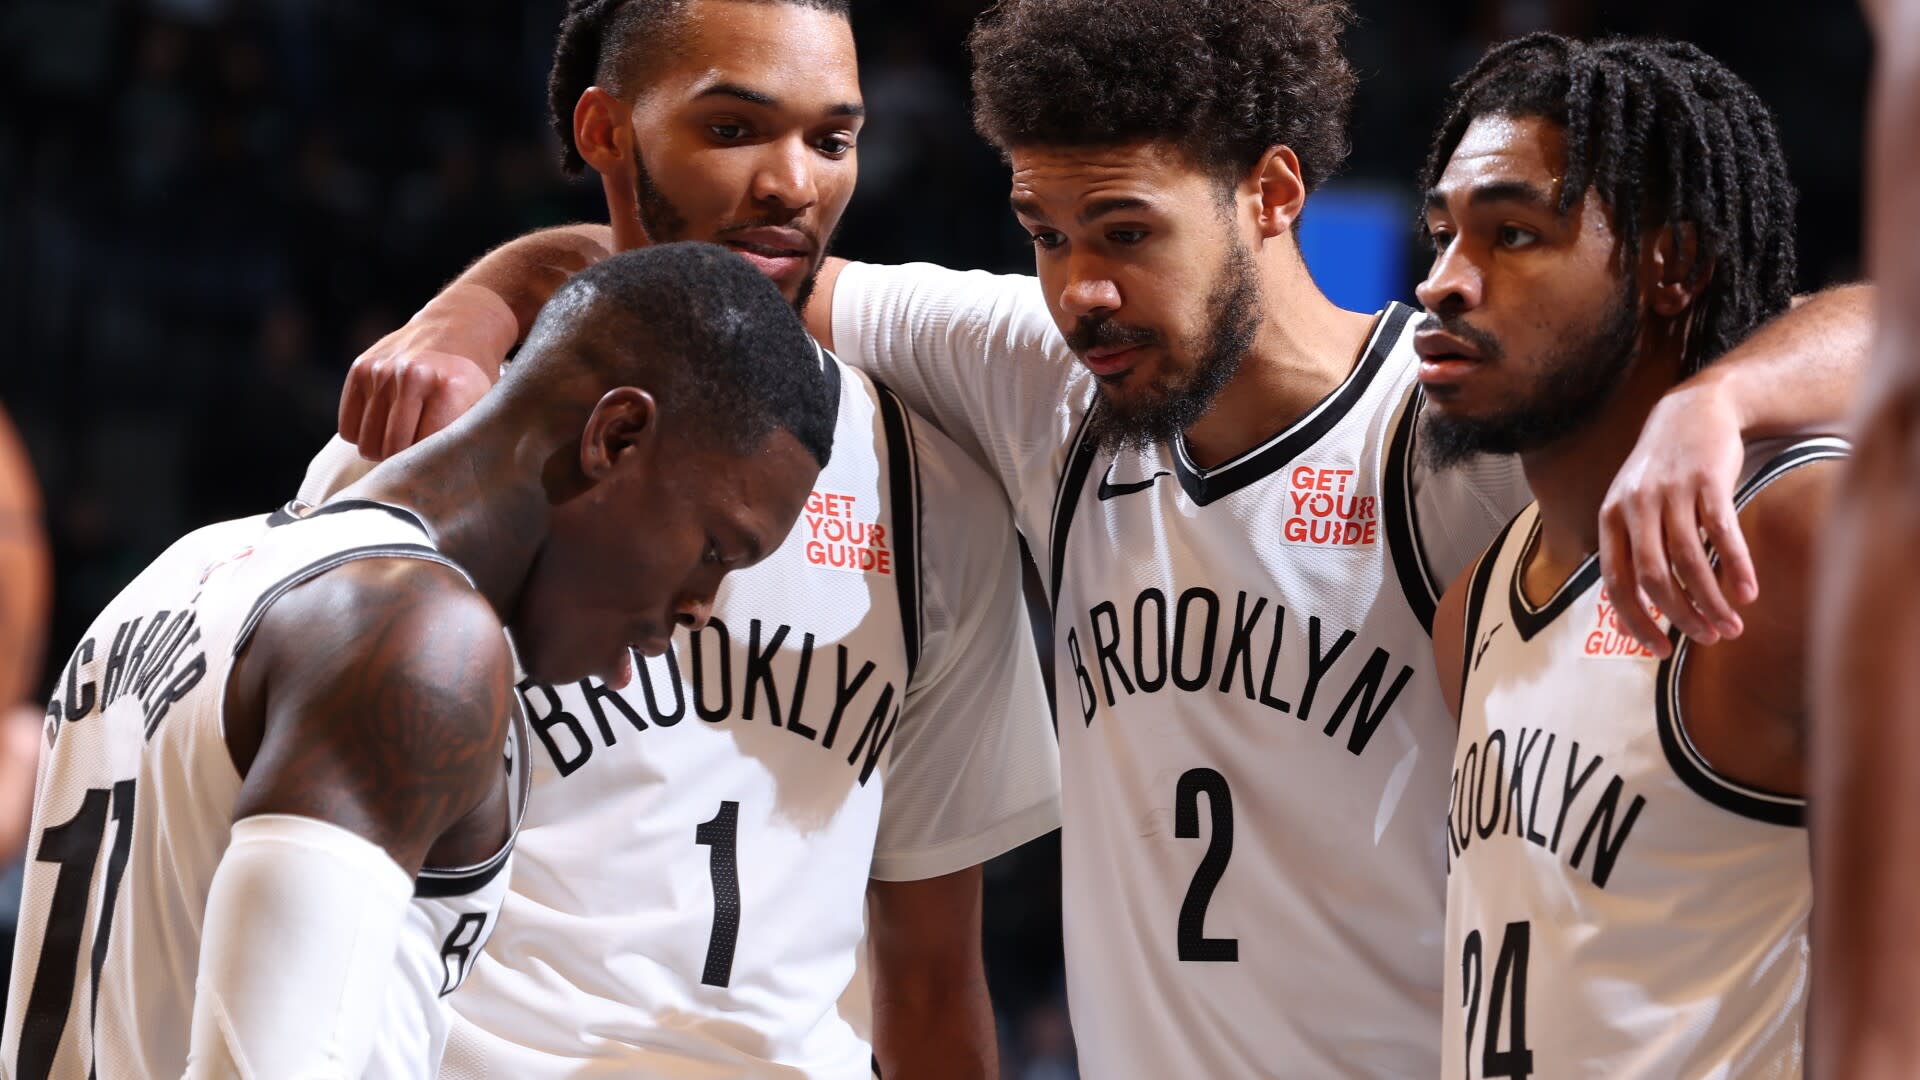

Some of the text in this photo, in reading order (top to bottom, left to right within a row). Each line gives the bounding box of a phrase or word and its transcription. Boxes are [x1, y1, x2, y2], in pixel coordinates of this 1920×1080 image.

[805, 490, 856, 519] GET
[1290, 491, 1376, 519] YOUR
[1291, 466, 1354, 492] GET
[805, 515, 887, 549] YOUR
[806, 541, 891, 575] GUIDE
[1284, 517, 1376, 545] GUIDE
[514, 616, 900, 788] BROOKLYN
[1067, 587, 1414, 756] BROOKLYN
[1447, 727, 1647, 889] ROOKLYN
[695, 800, 741, 989] 1
[1175, 767, 1239, 962] 2
[1460, 920, 1534, 1080] 24
